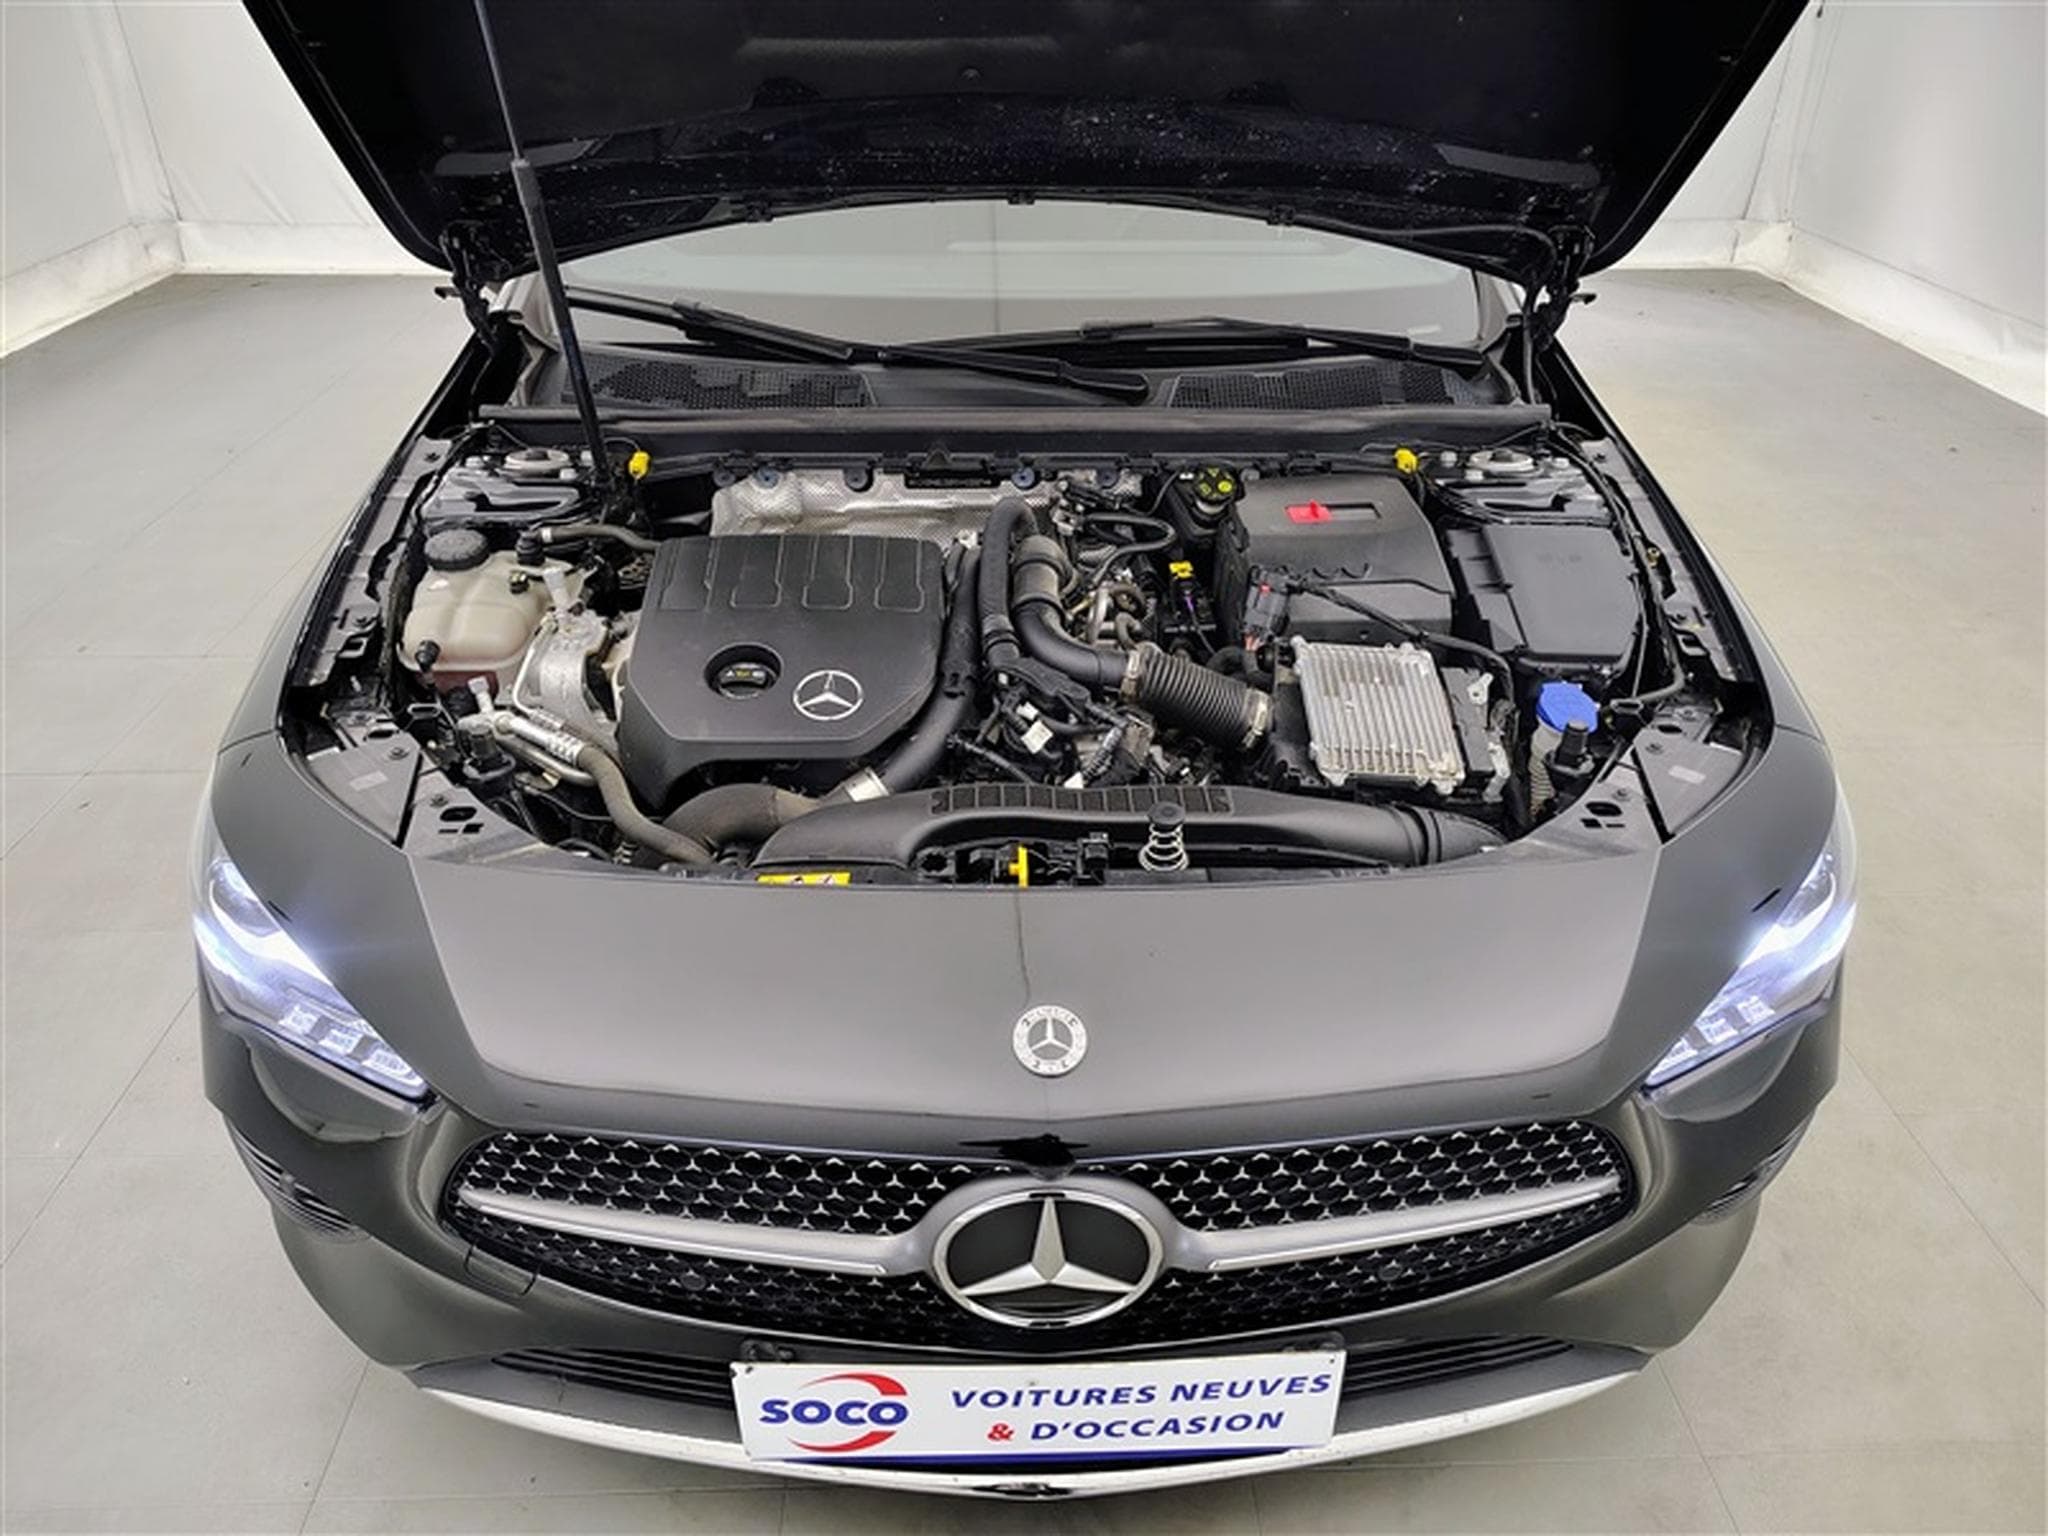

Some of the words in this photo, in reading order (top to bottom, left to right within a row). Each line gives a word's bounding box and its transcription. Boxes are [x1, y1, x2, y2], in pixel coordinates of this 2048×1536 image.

[951, 1385, 1156, 1409] VOITURES
[1170, 1374, 1331, 1402] NEUVES
[759, 1399, 909, 1426] SOCO
[986, 1422, 1014, 1442] &
[1030, 1411, 1284, 1441] D'OCCASION
